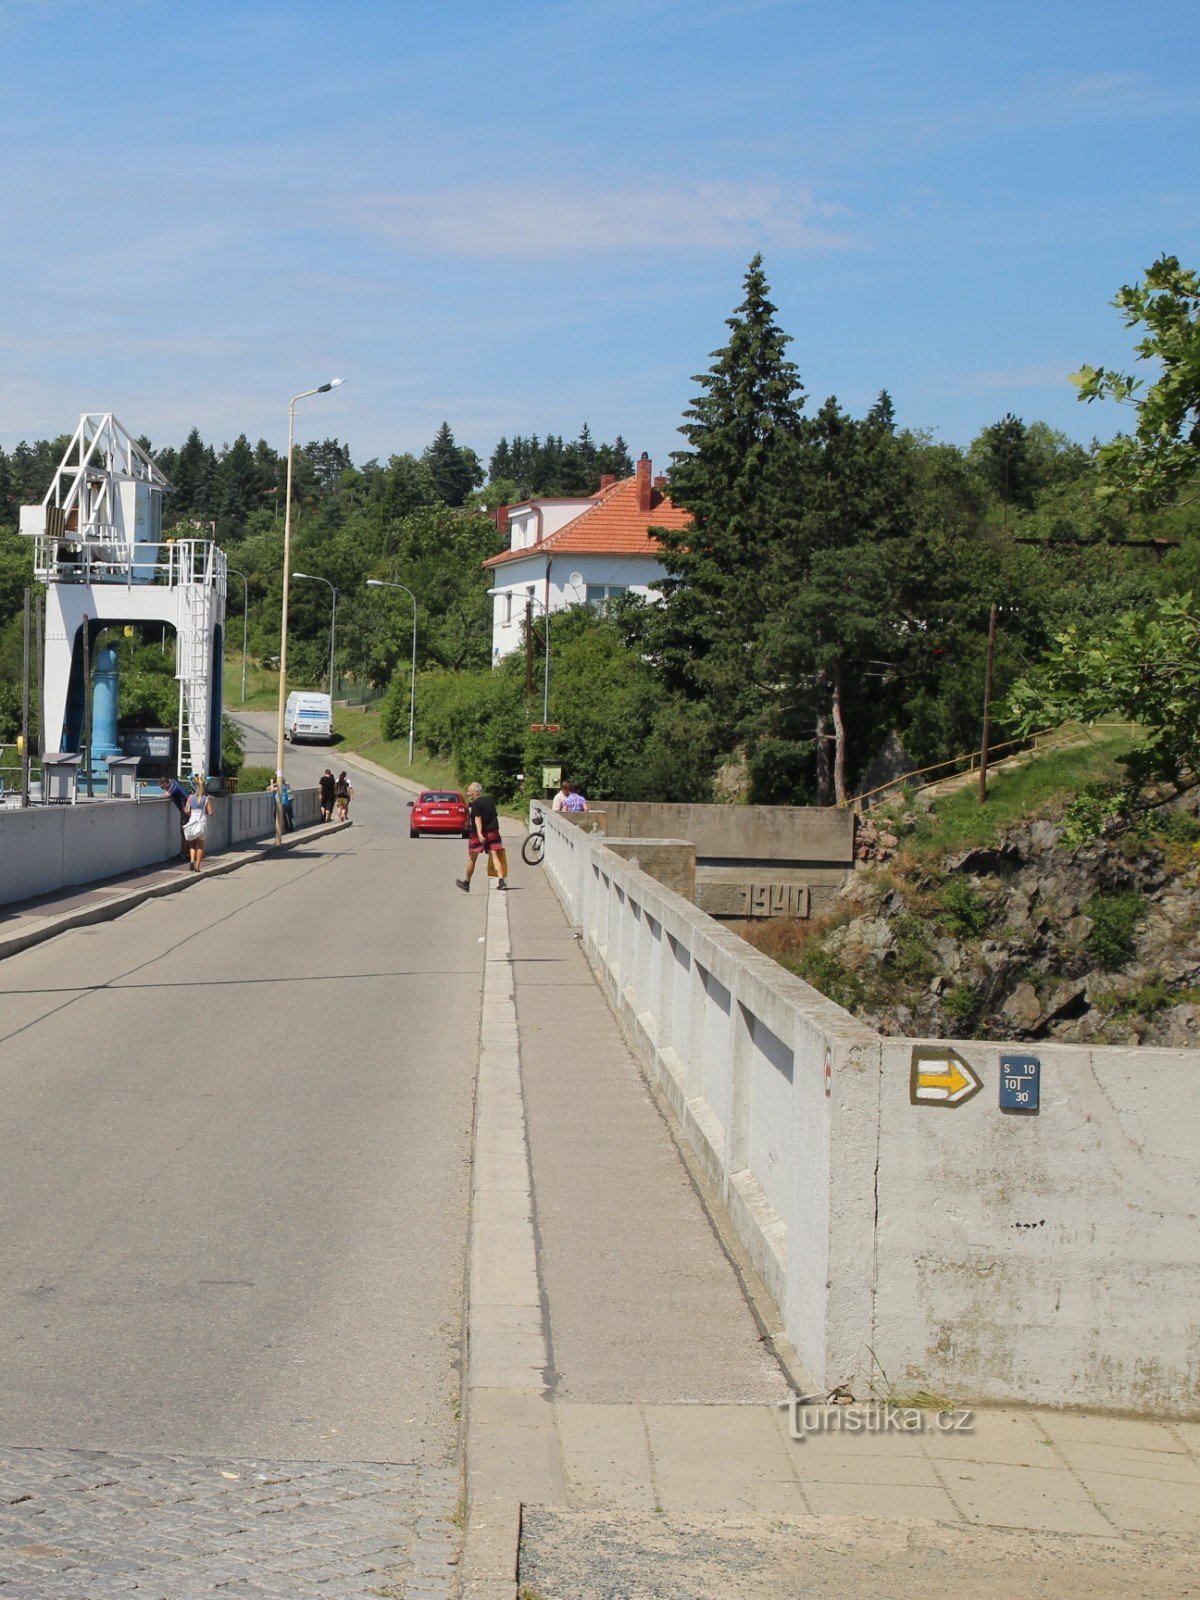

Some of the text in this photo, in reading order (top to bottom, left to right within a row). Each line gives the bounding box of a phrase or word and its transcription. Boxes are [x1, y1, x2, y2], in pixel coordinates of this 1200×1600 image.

[737, 884, 808, 917] 1940
[1003, 1063, 1035, 1074] S 10
[1005, 1079, 1017, 1089] 10
[1015, 1092, 1029, 1102] 30
